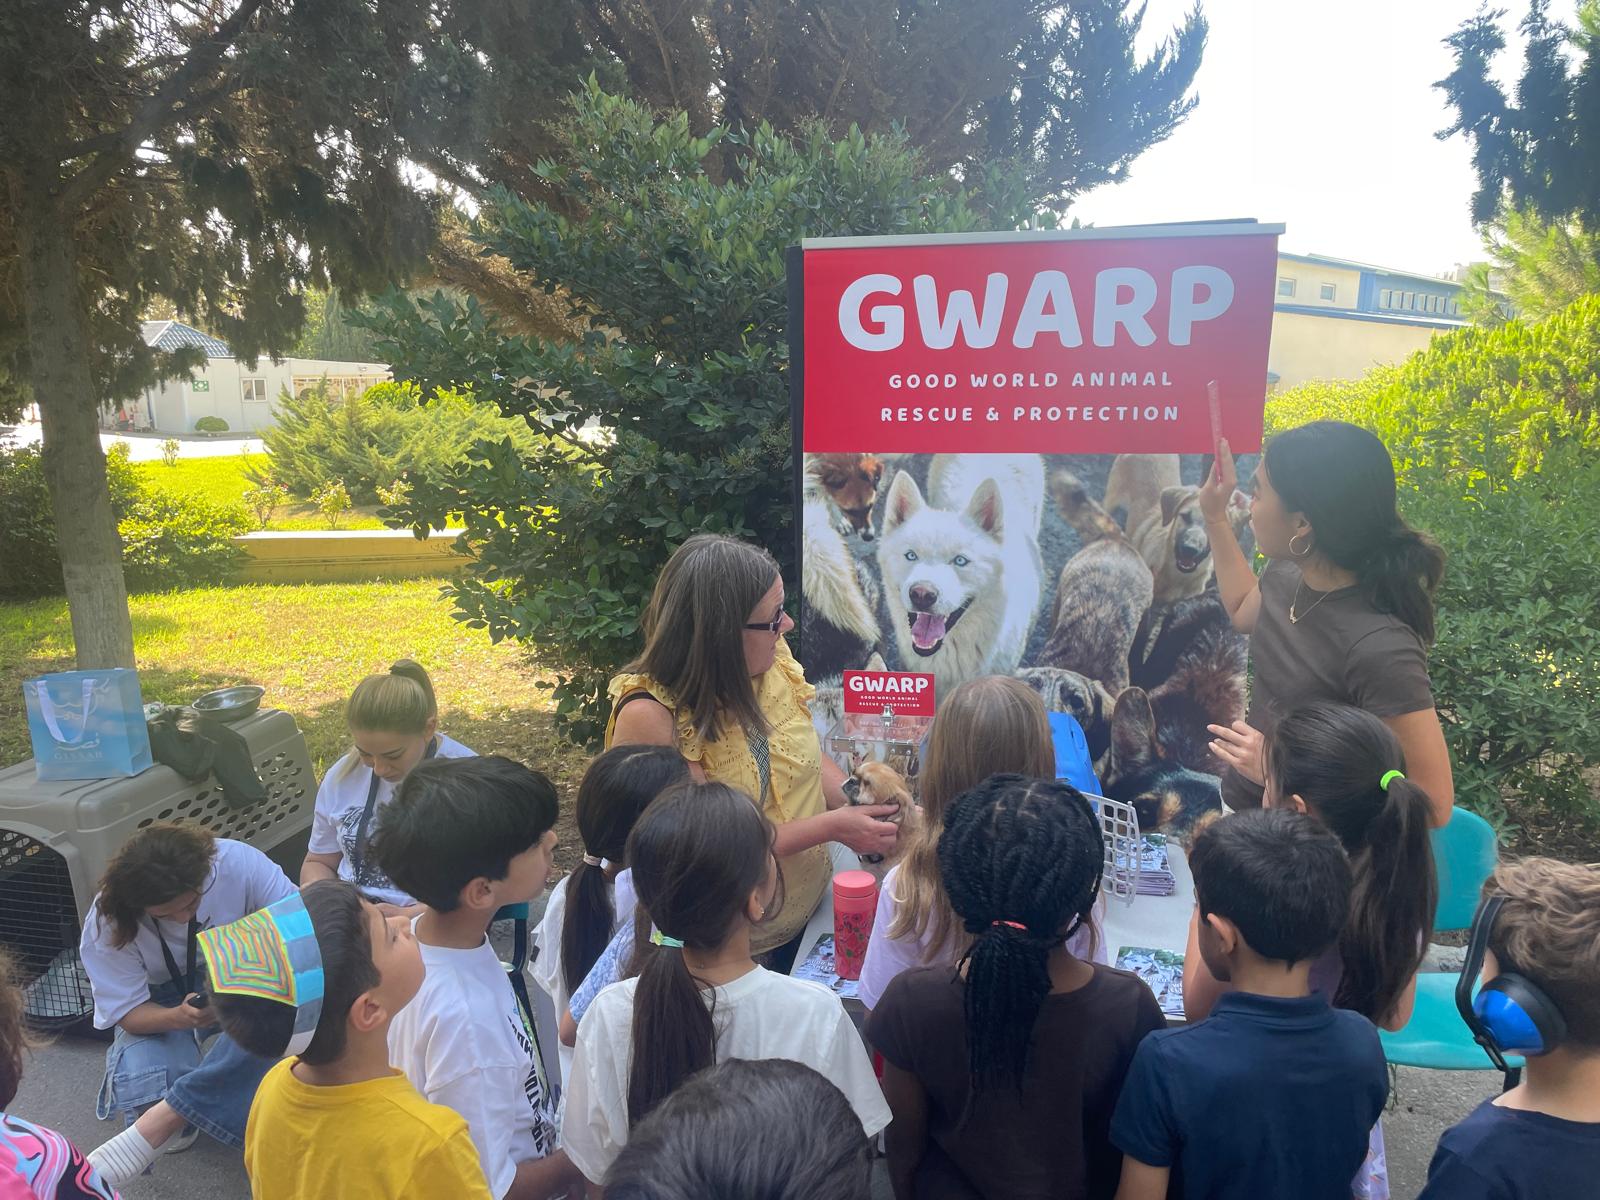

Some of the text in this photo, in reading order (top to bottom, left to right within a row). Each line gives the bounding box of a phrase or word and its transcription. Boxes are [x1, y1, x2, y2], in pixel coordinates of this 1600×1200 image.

[838, 265, 1235, 352] GWARP
[889, 371, 1172, 389] GOOD WORLD ANIMAL
[881, 406, 1178, 422] RESCUE & PROTECTION
[849, 676, 929, 693] GWARP
